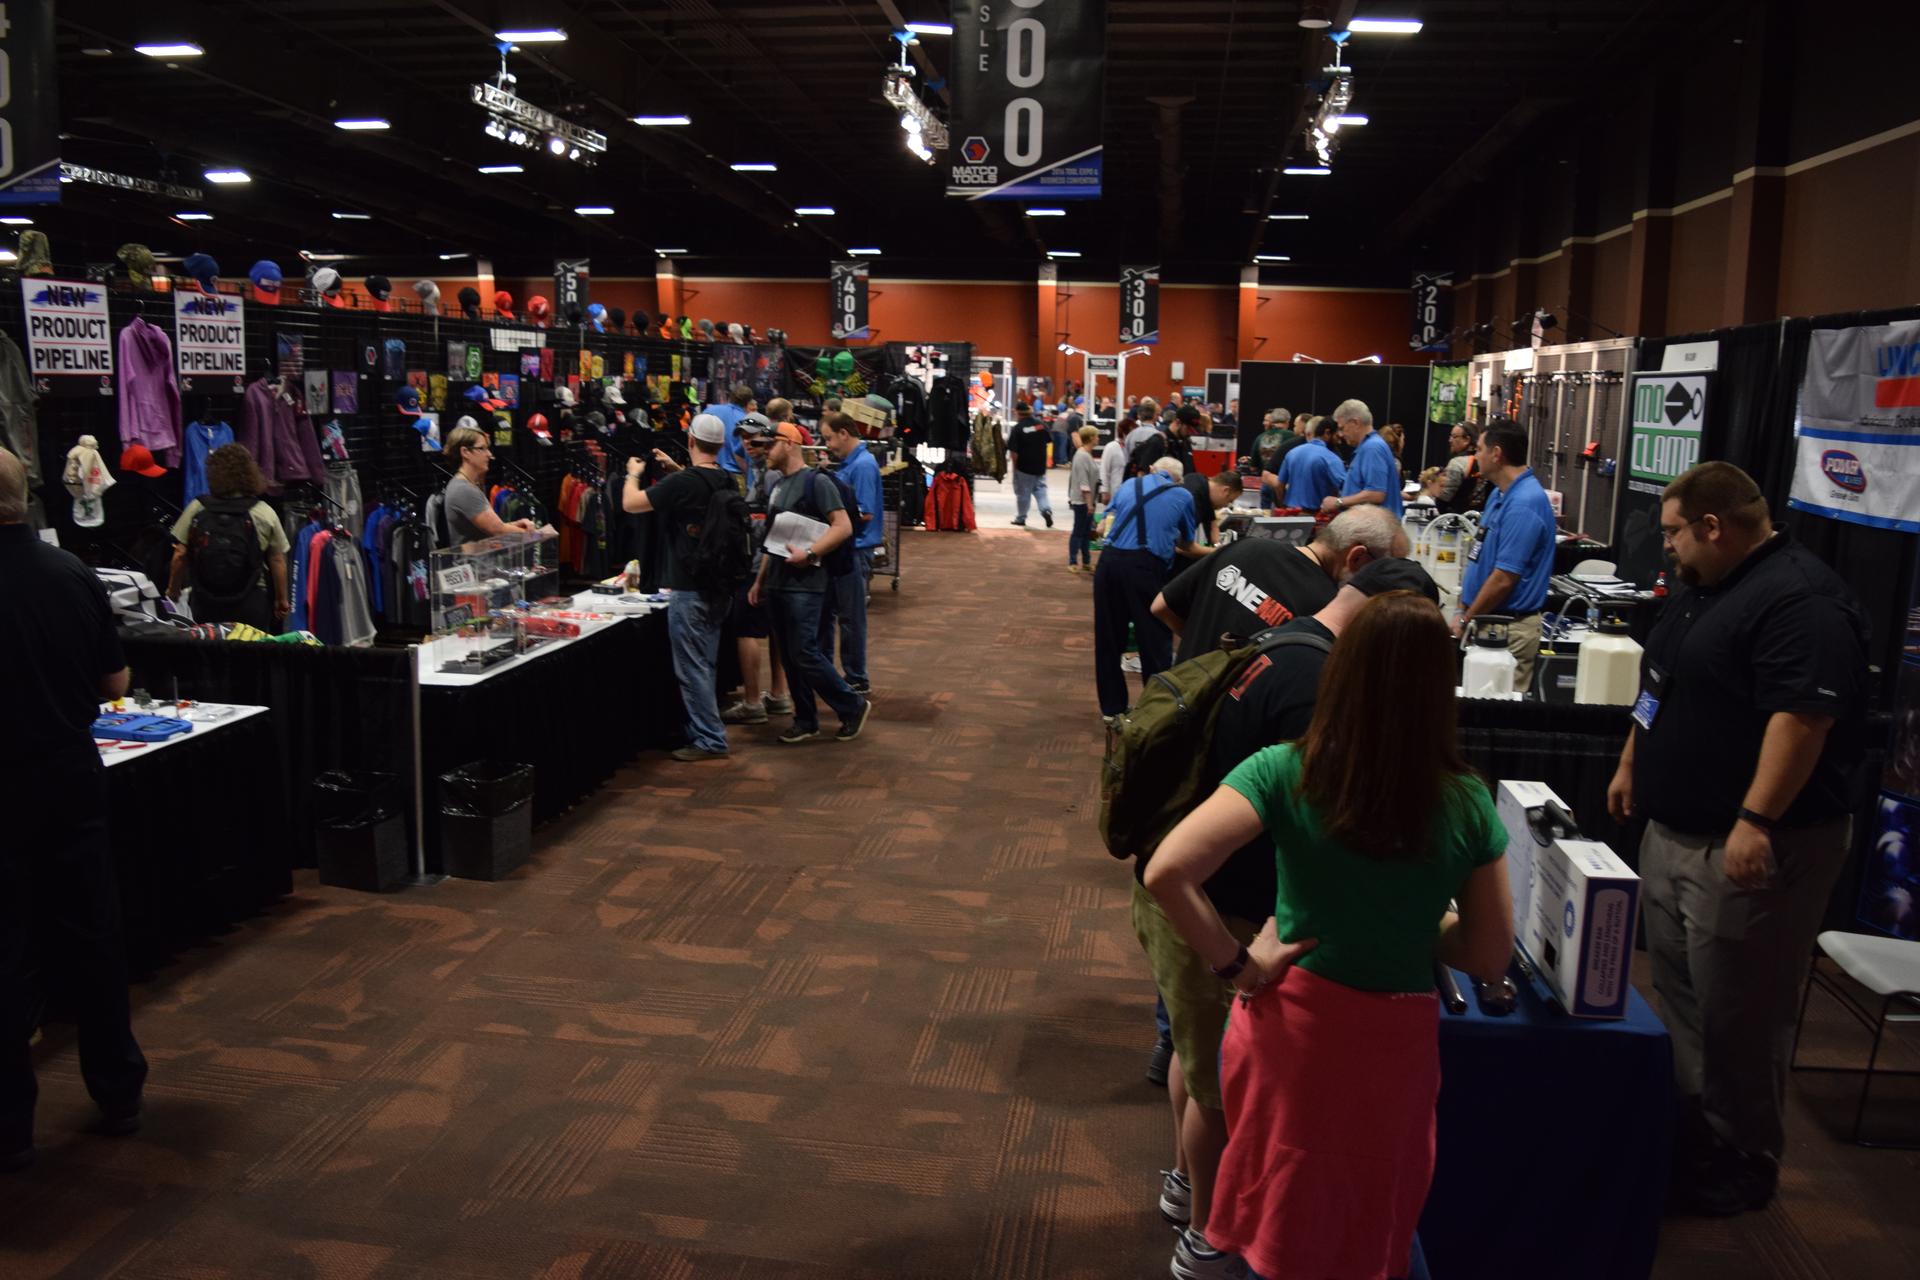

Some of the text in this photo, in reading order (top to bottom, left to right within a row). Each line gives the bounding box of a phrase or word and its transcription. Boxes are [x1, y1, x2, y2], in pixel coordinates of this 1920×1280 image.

[1003, 0, 1046, 167] 00
[952, 165, 998, 175] MATCO
[952, 175, 998, 184] TOOLS
[46, 284, 86, 307] NEW
[566, 272, 577, 302] 50
[194, 296, 226, 316] NEW
[843, 275, 856, 332] 400
[1132, 279, 1145, 337] 300
[1423, 285, 1438, 344] 200
[31, 315, 106, 340] PRODUCT
[180, 323, 242, 346] PRODUCT
[34, 348, 110, 370] PIPELINE
[180, 352, 243, 372] PIPELINE
[1634, 384, 1665, 424] MO
[1631, 433, 1700, 478] CLAMP
[1825, 457, 1860, 476] POWER
[1216, 564, 1294, 627] ONE MATC
[1597, 902, 1614, 996] COLLAPSES AND LENGTHENS
[1605, 980, 1614, 997] WITH
[1610, 946, 1618, 965] PRESS
